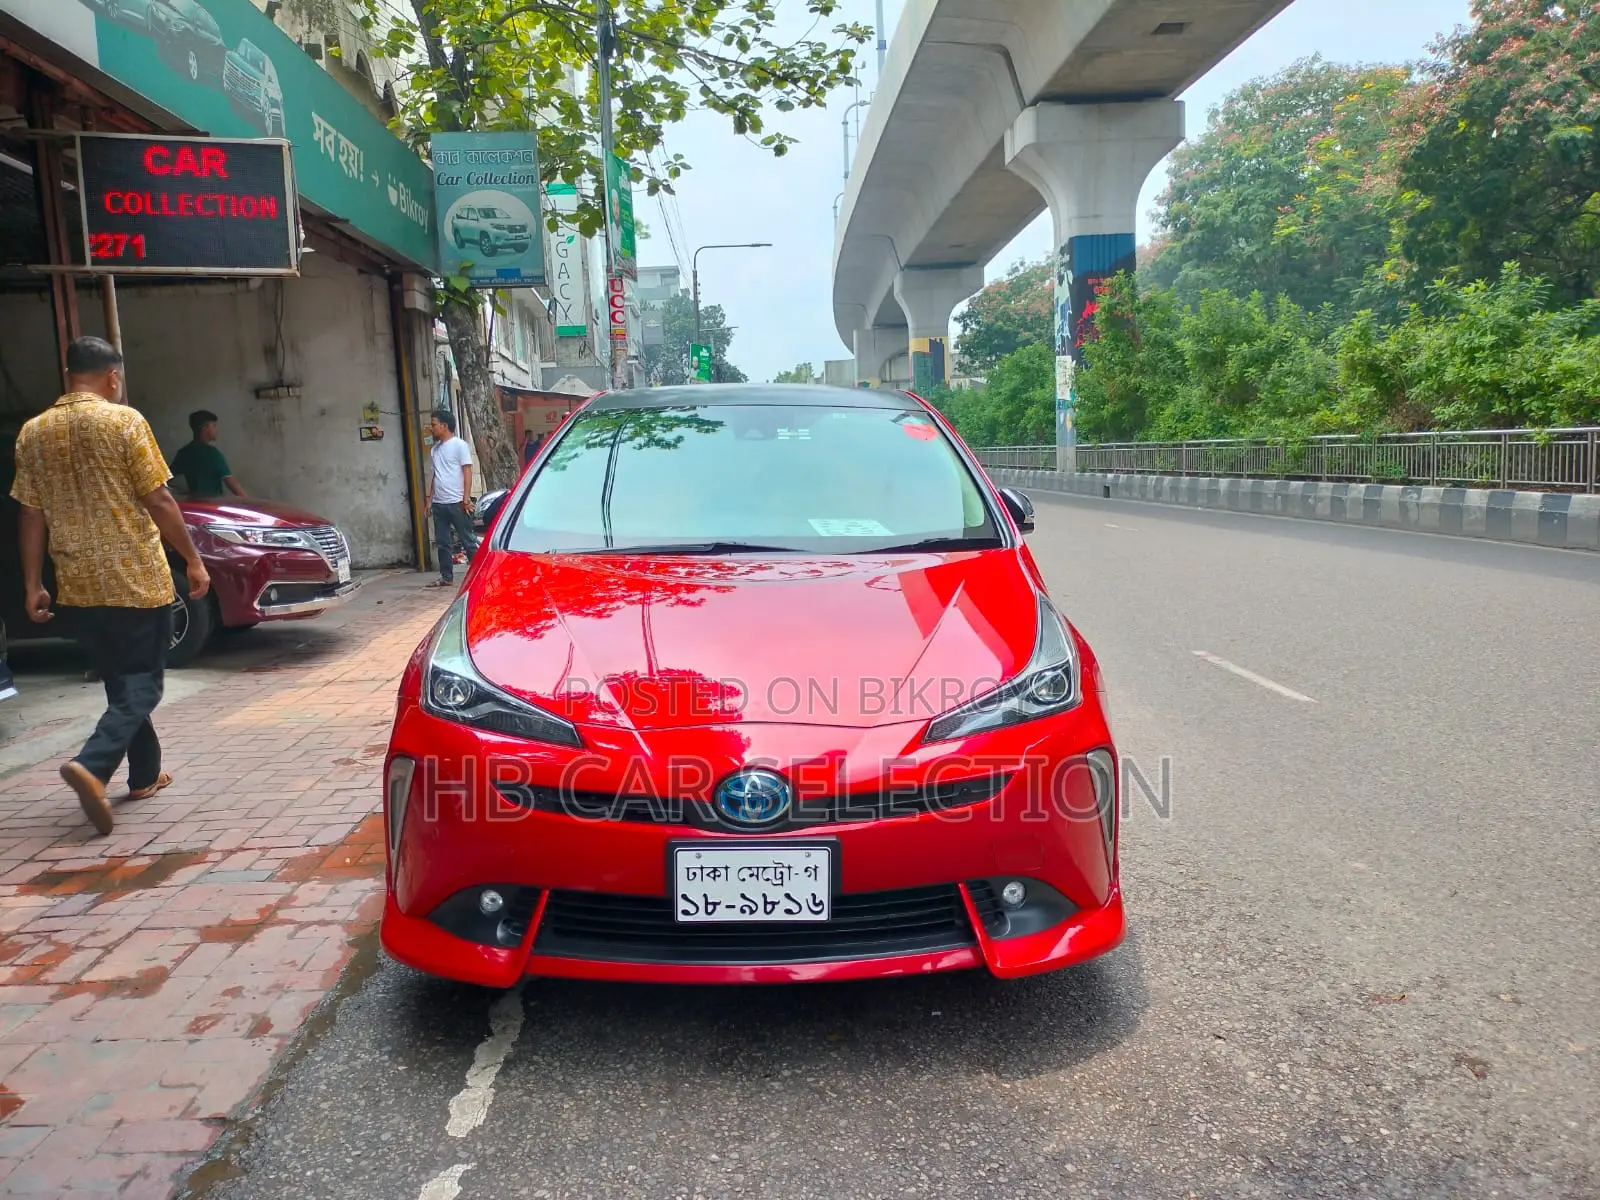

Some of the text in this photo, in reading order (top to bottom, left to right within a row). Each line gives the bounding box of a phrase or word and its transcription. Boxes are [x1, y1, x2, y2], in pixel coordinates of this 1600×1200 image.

[312, 111, 337, 162] সব
[143, 144, 228, 178] CAR
[435, 149, 534, 165] কার কালেকশন
[436, 171, 537, 186] Car Collection
[103, 190, 278, 219] COLLECTION
[399, 181, 429, 234] Bikroy
[685, 864, 731, 882] ঢাকা
[680, 892, 825, 916] ১৮-৯৮১৬
